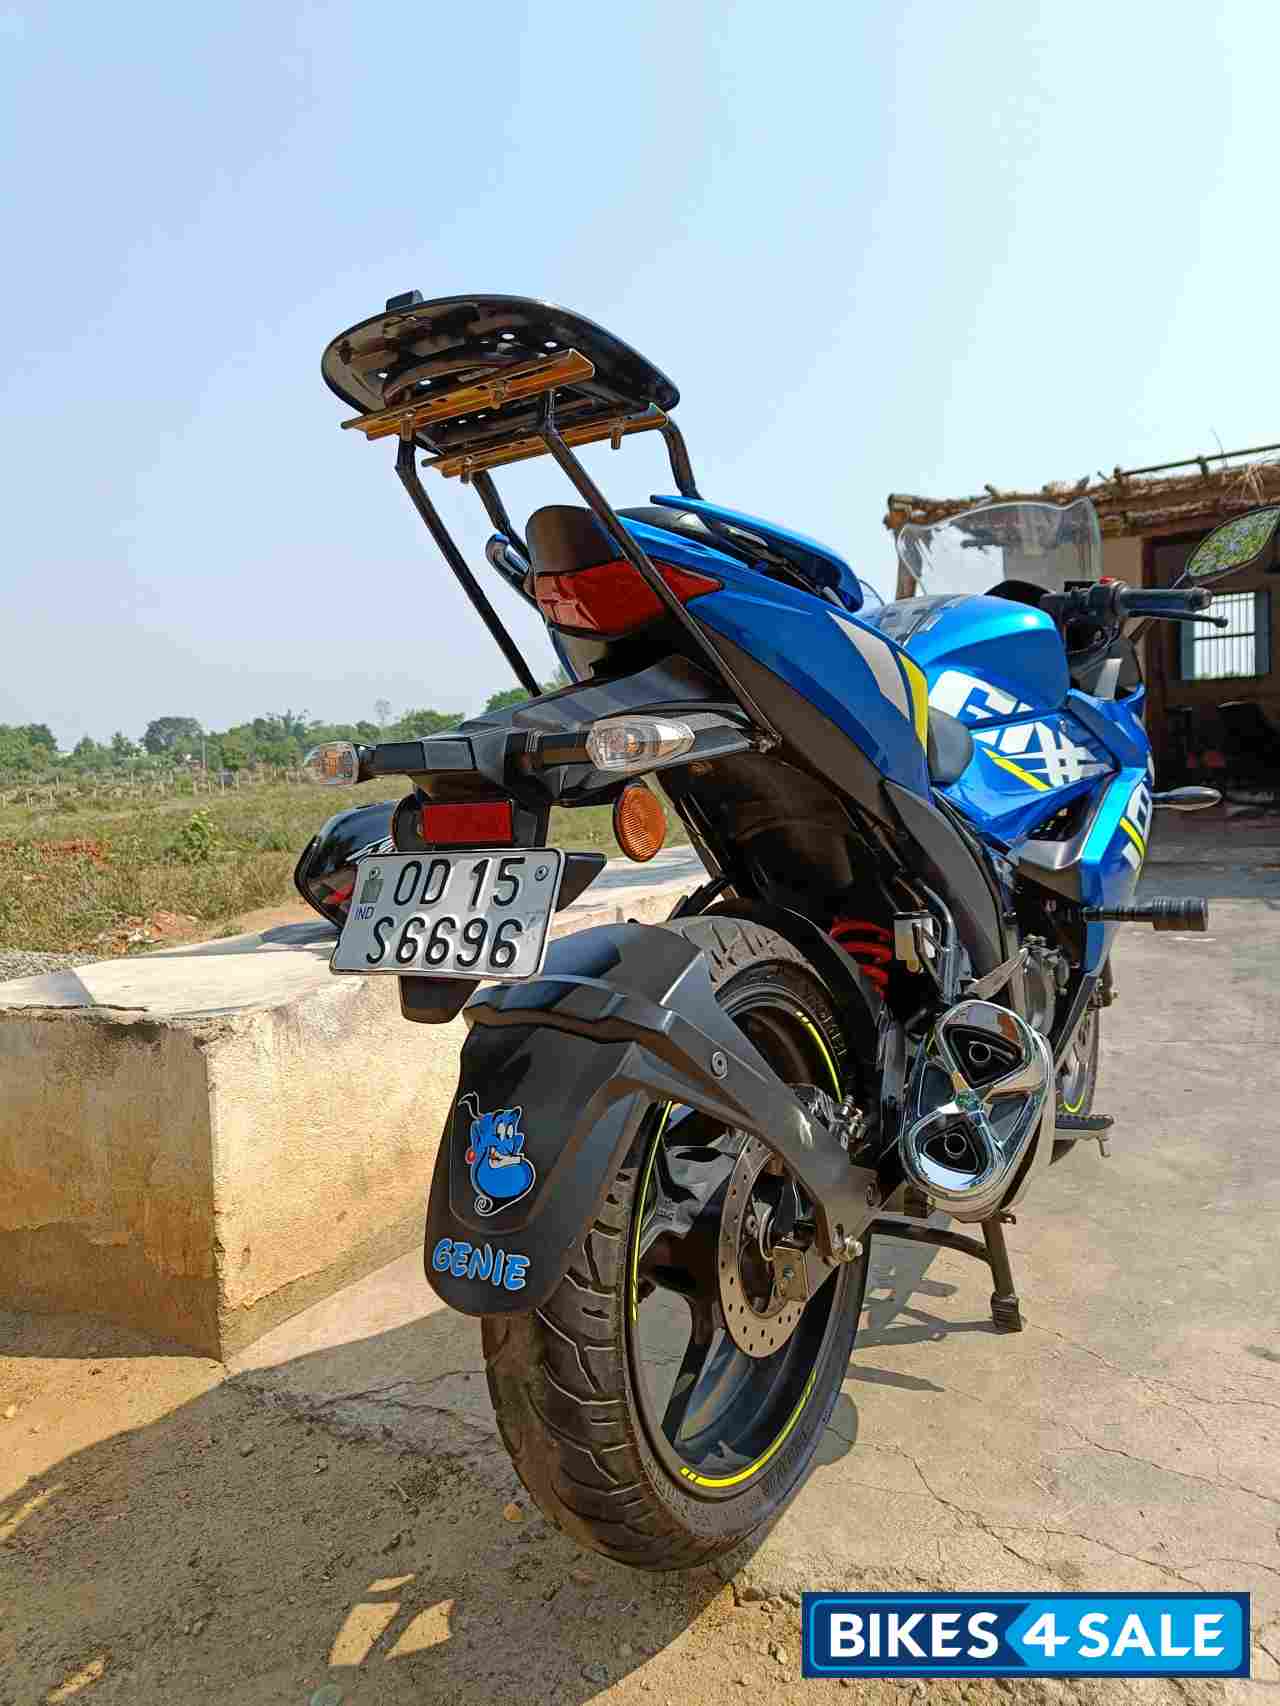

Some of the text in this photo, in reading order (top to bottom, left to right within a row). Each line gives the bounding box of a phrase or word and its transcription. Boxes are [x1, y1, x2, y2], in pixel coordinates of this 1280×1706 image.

[472, 857, 525, 906] 15
[354, 906, 375, 920] IND
[366, 916, 523, 968] S6696
[432, 1238, 530, 1291] GENIE
